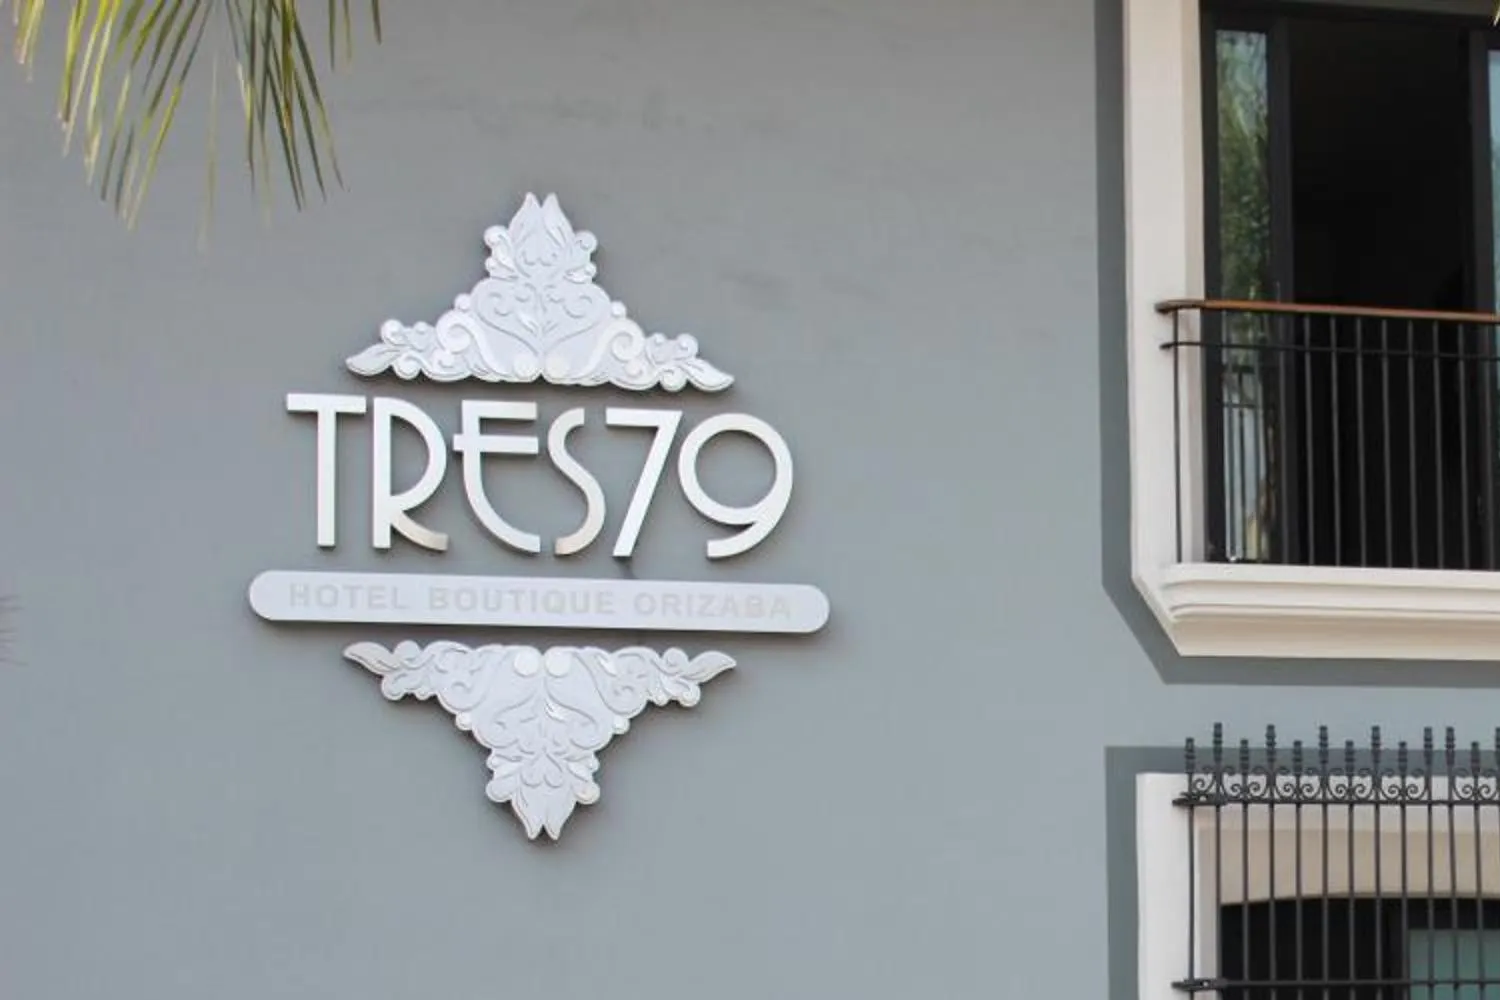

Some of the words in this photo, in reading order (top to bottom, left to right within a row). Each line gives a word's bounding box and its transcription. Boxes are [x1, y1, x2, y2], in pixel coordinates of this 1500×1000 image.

[286, 392, 794, 559] TRES79
[287, 581, 409, 611] HOTEL
[427, 585, 616, 616] BOUTIQUE
[632, 590, 793, 620] ORIZABA
